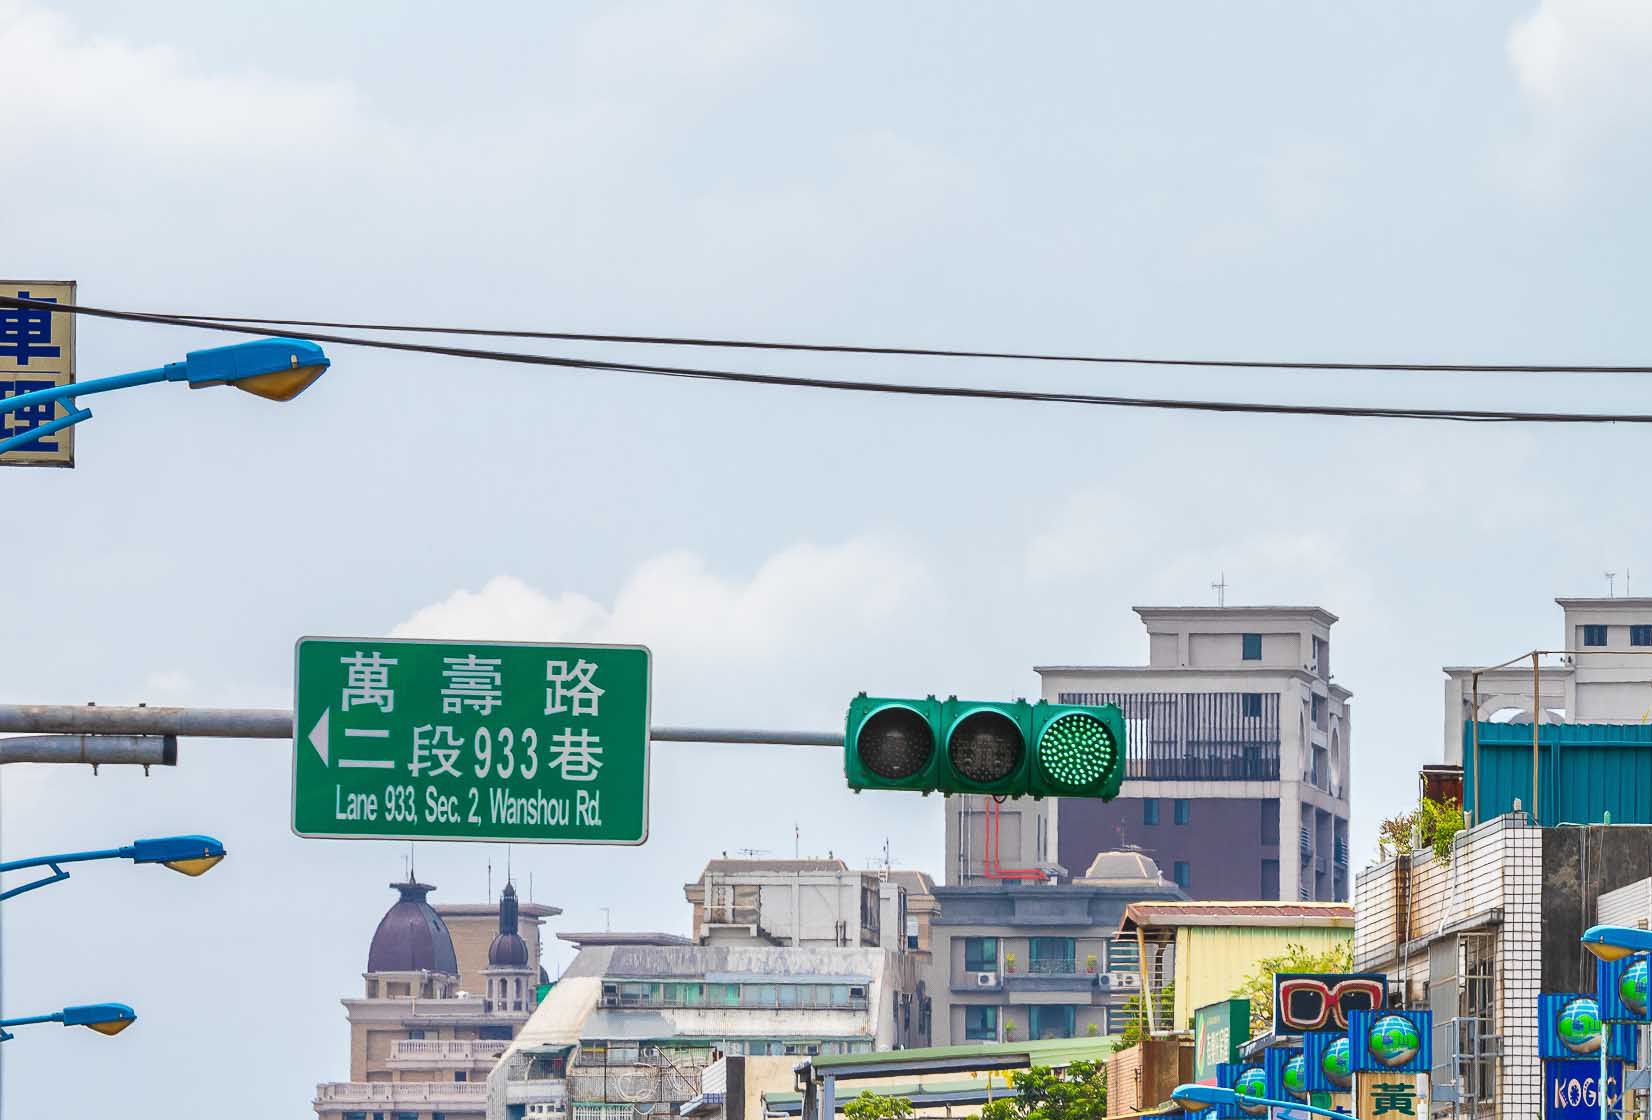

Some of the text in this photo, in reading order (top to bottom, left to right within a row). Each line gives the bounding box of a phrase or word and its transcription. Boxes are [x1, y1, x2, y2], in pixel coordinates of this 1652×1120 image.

[340, 651, 606, 717] 萬壽路
[337, 724, 604, 782] 二段933巷
[336, 784, 378, 822] Lane
[425, 787, 461, 824] Sec.
[489, 787, 570, 826] Wanshou
[577, 789, 602, 827] Rd.
